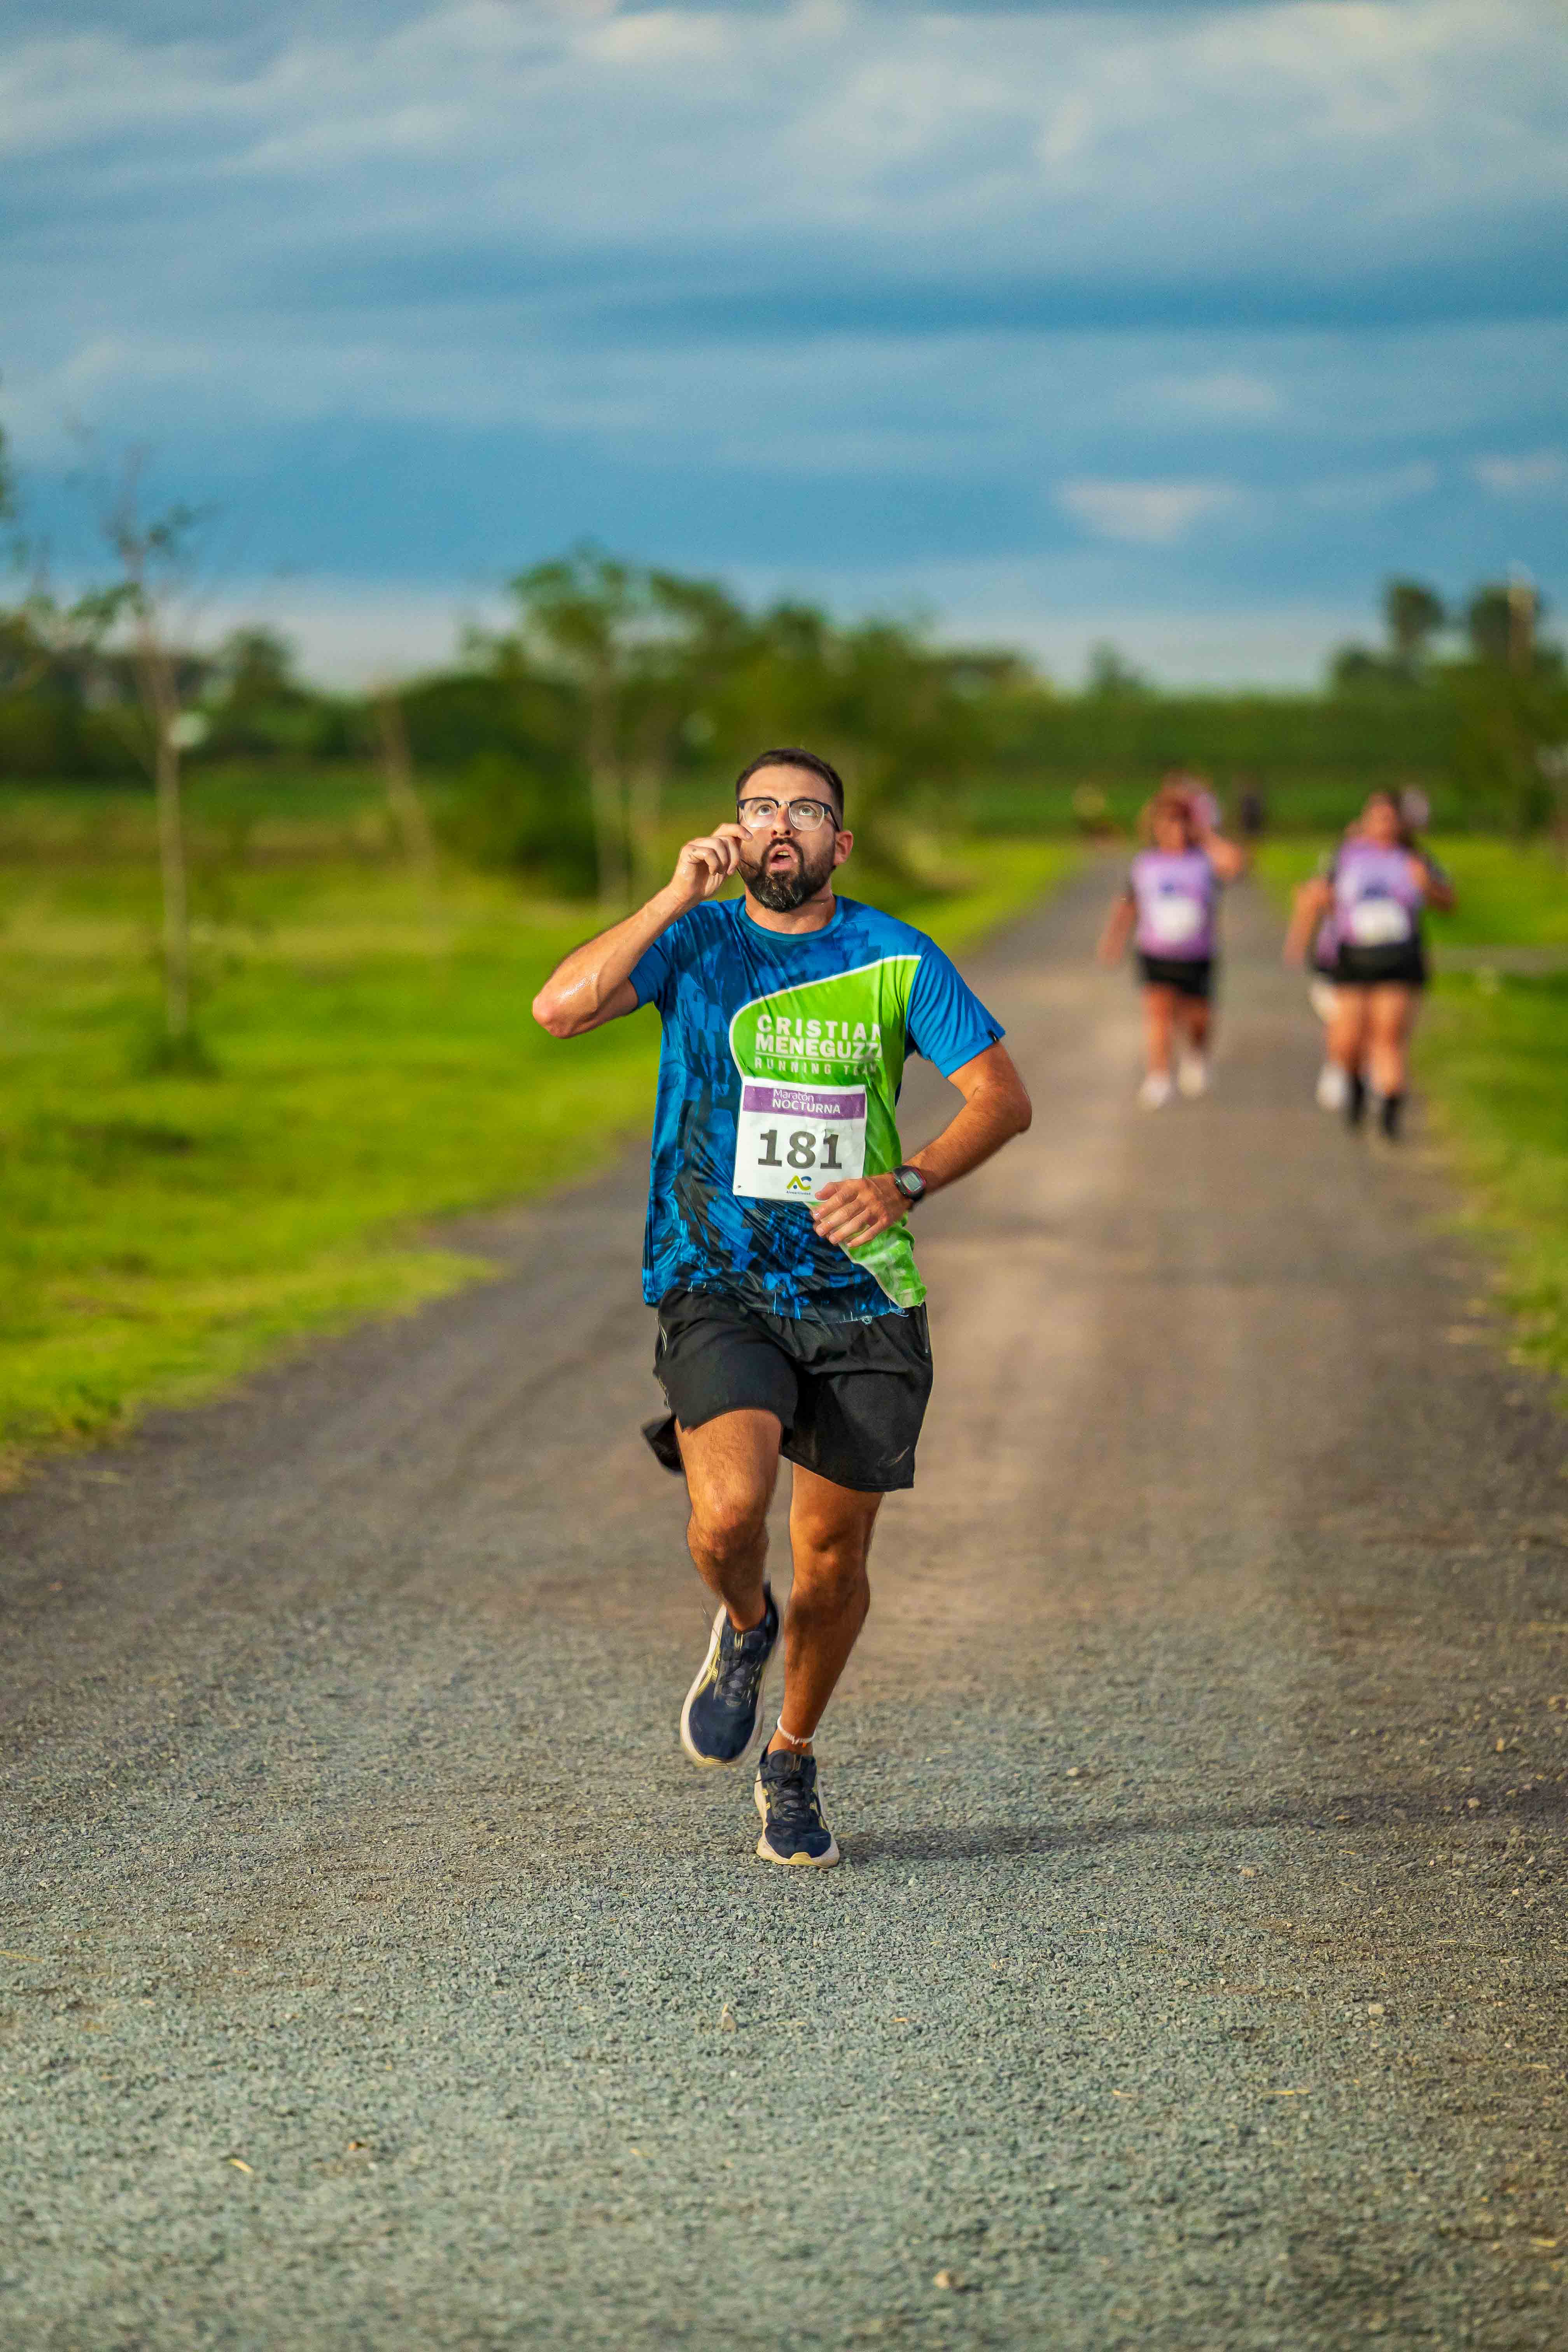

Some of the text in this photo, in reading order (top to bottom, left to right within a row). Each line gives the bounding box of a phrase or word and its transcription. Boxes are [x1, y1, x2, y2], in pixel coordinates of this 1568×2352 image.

[754, 1057, 831, 1075] RUNNING
[773, 1088, 814, 1102] Maratón
[772, 1098, 840, 1114] NOCTURNA
[758, 1129, 842, 1169] 181
